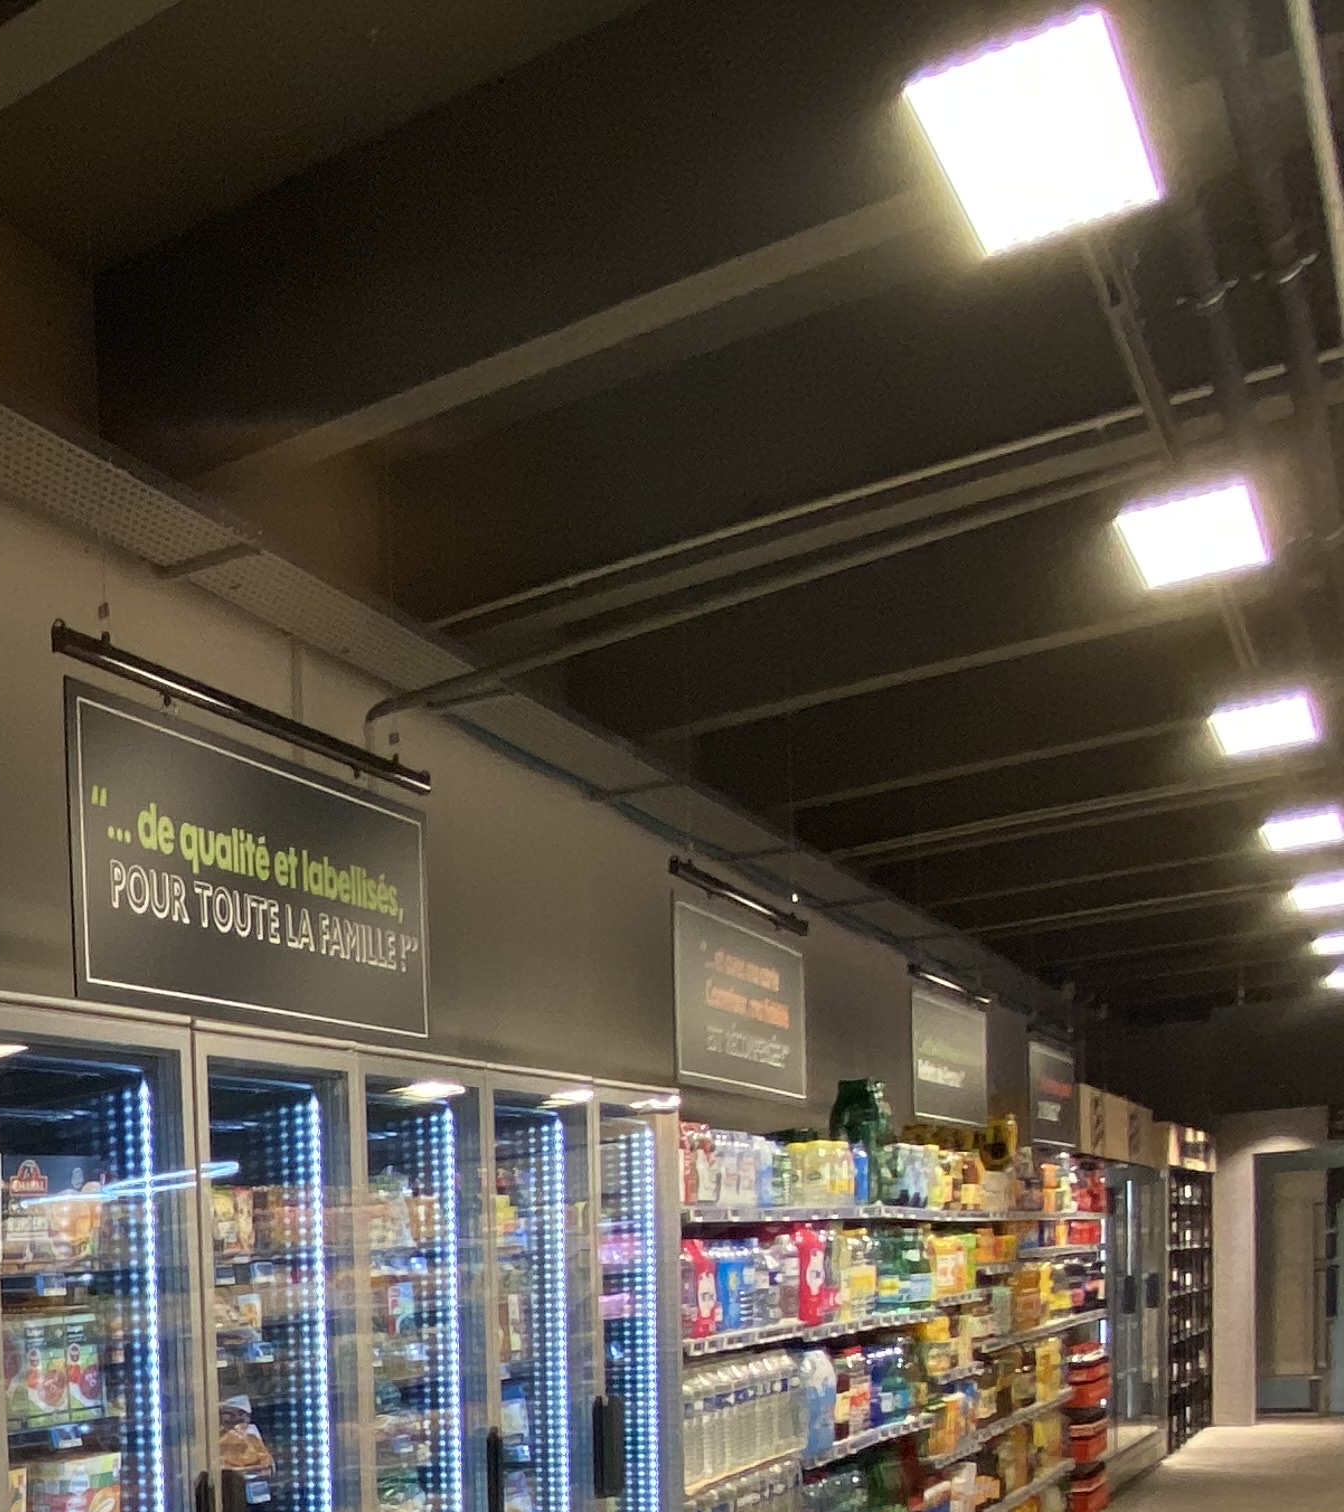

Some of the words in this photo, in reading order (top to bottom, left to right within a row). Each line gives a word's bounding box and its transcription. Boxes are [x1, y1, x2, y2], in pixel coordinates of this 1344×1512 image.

[109, 858, 191, 926] POUR
[193, 880, 281, 945] TOUTE
[284, 902, 316, 954] LA
[318, 912, 397, 973] FAMILLE
[137, 802, 176, 855] de
[179, 821, 271, 882] qualité
[273, 846, 299, 890] et
[301, 849, 405, 924] labellisés,
